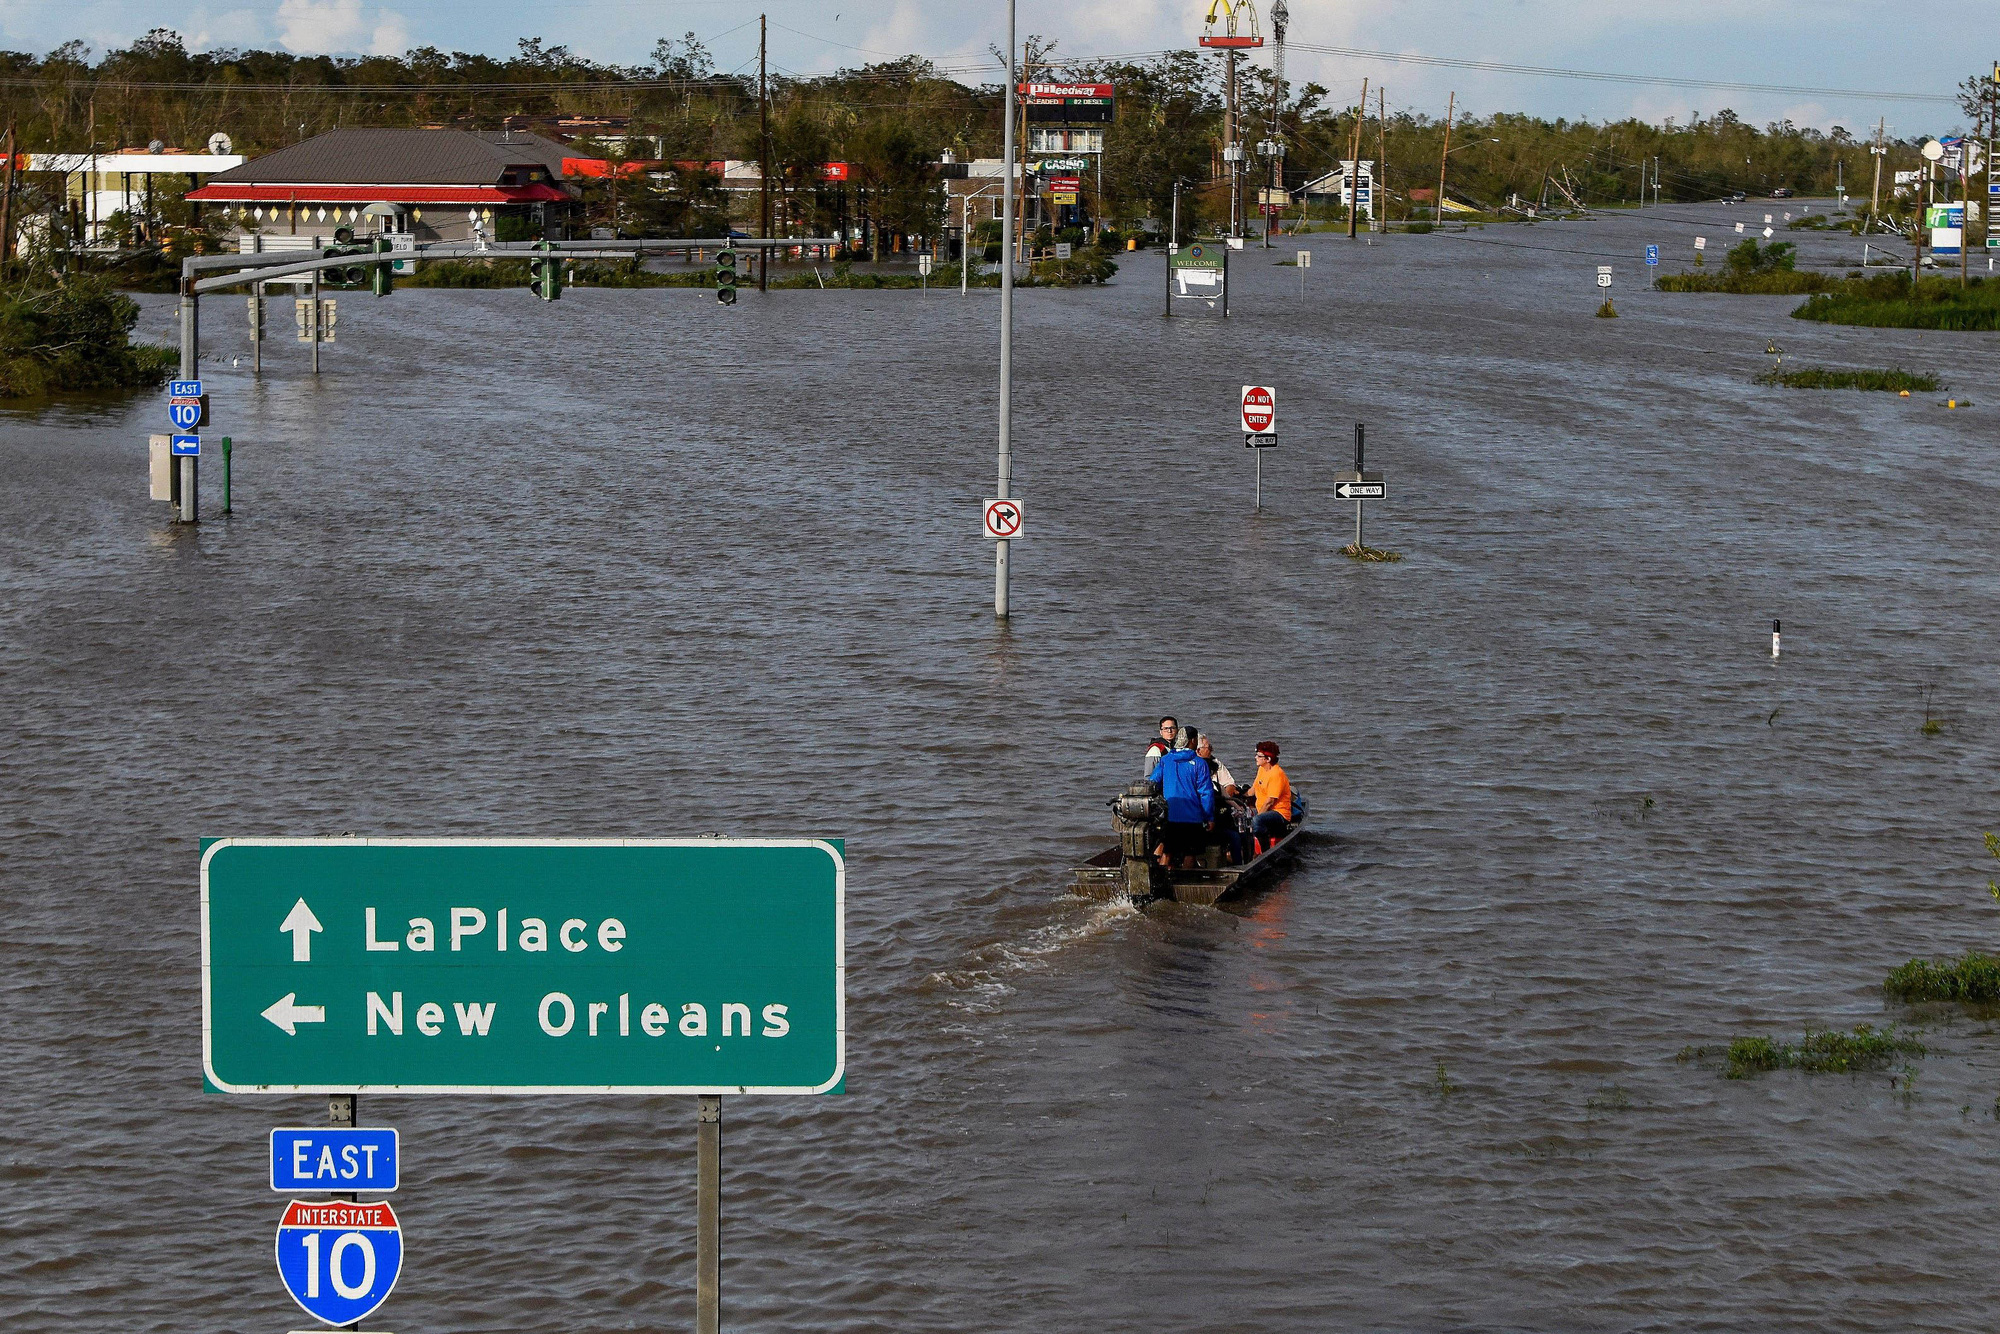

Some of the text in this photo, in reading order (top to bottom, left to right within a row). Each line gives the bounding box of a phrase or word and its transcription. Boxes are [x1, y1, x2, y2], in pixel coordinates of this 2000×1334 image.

[1045, 159, 1084, 170] CASINO
[1600, 276, 1609, 284] 51
[174, 383, 198, 395] EAST
[1246, 395, 1270, 404] DO NOT
[175, 405, 196, 424] 10
[1248, 415, 1268, 424] ENTER
[366, 908, 625, 952] LaPlace
[367, 992, 789, 1037] New Orleans
[294, 1141, 378, 1178] EAST
[297, 1209, 382, 1225] INTERSTATE
[303, 1233, 375, 1299] 10
